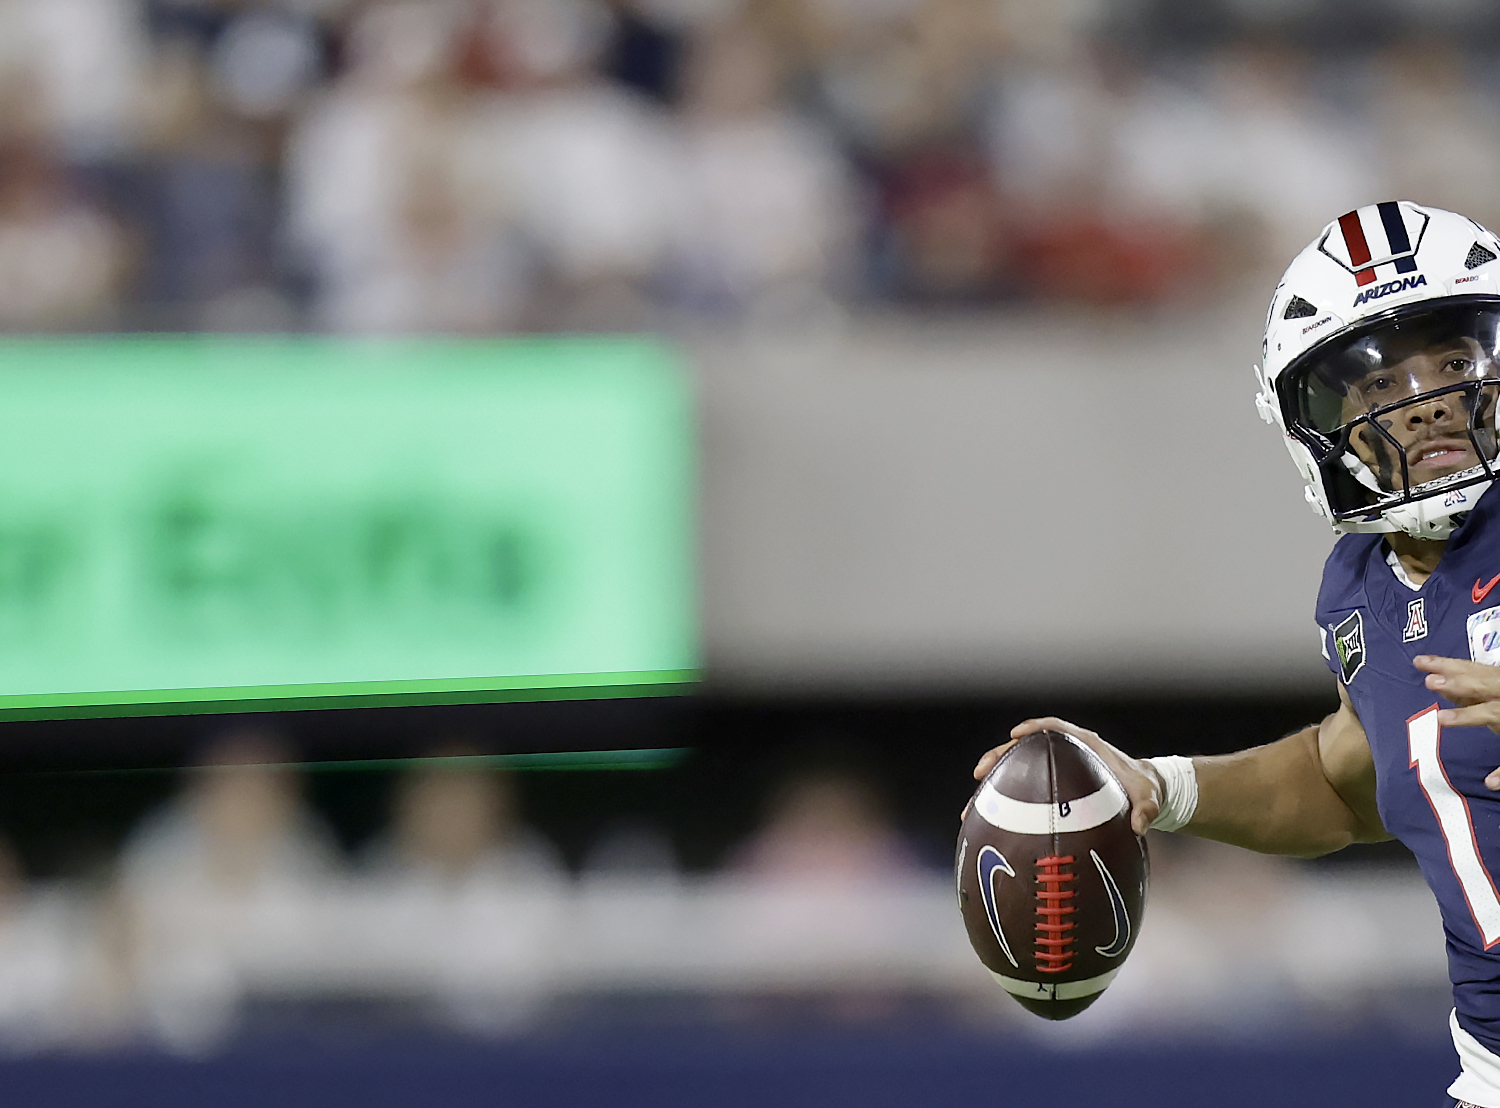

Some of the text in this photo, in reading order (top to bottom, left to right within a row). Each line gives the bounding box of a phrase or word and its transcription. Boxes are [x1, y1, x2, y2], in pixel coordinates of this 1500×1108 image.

[1353, 274, 1427, 308] ARIZONA
[1302, 316, 1332, 335] BEARDOWN
[1402, 597, 1428, 643] A
